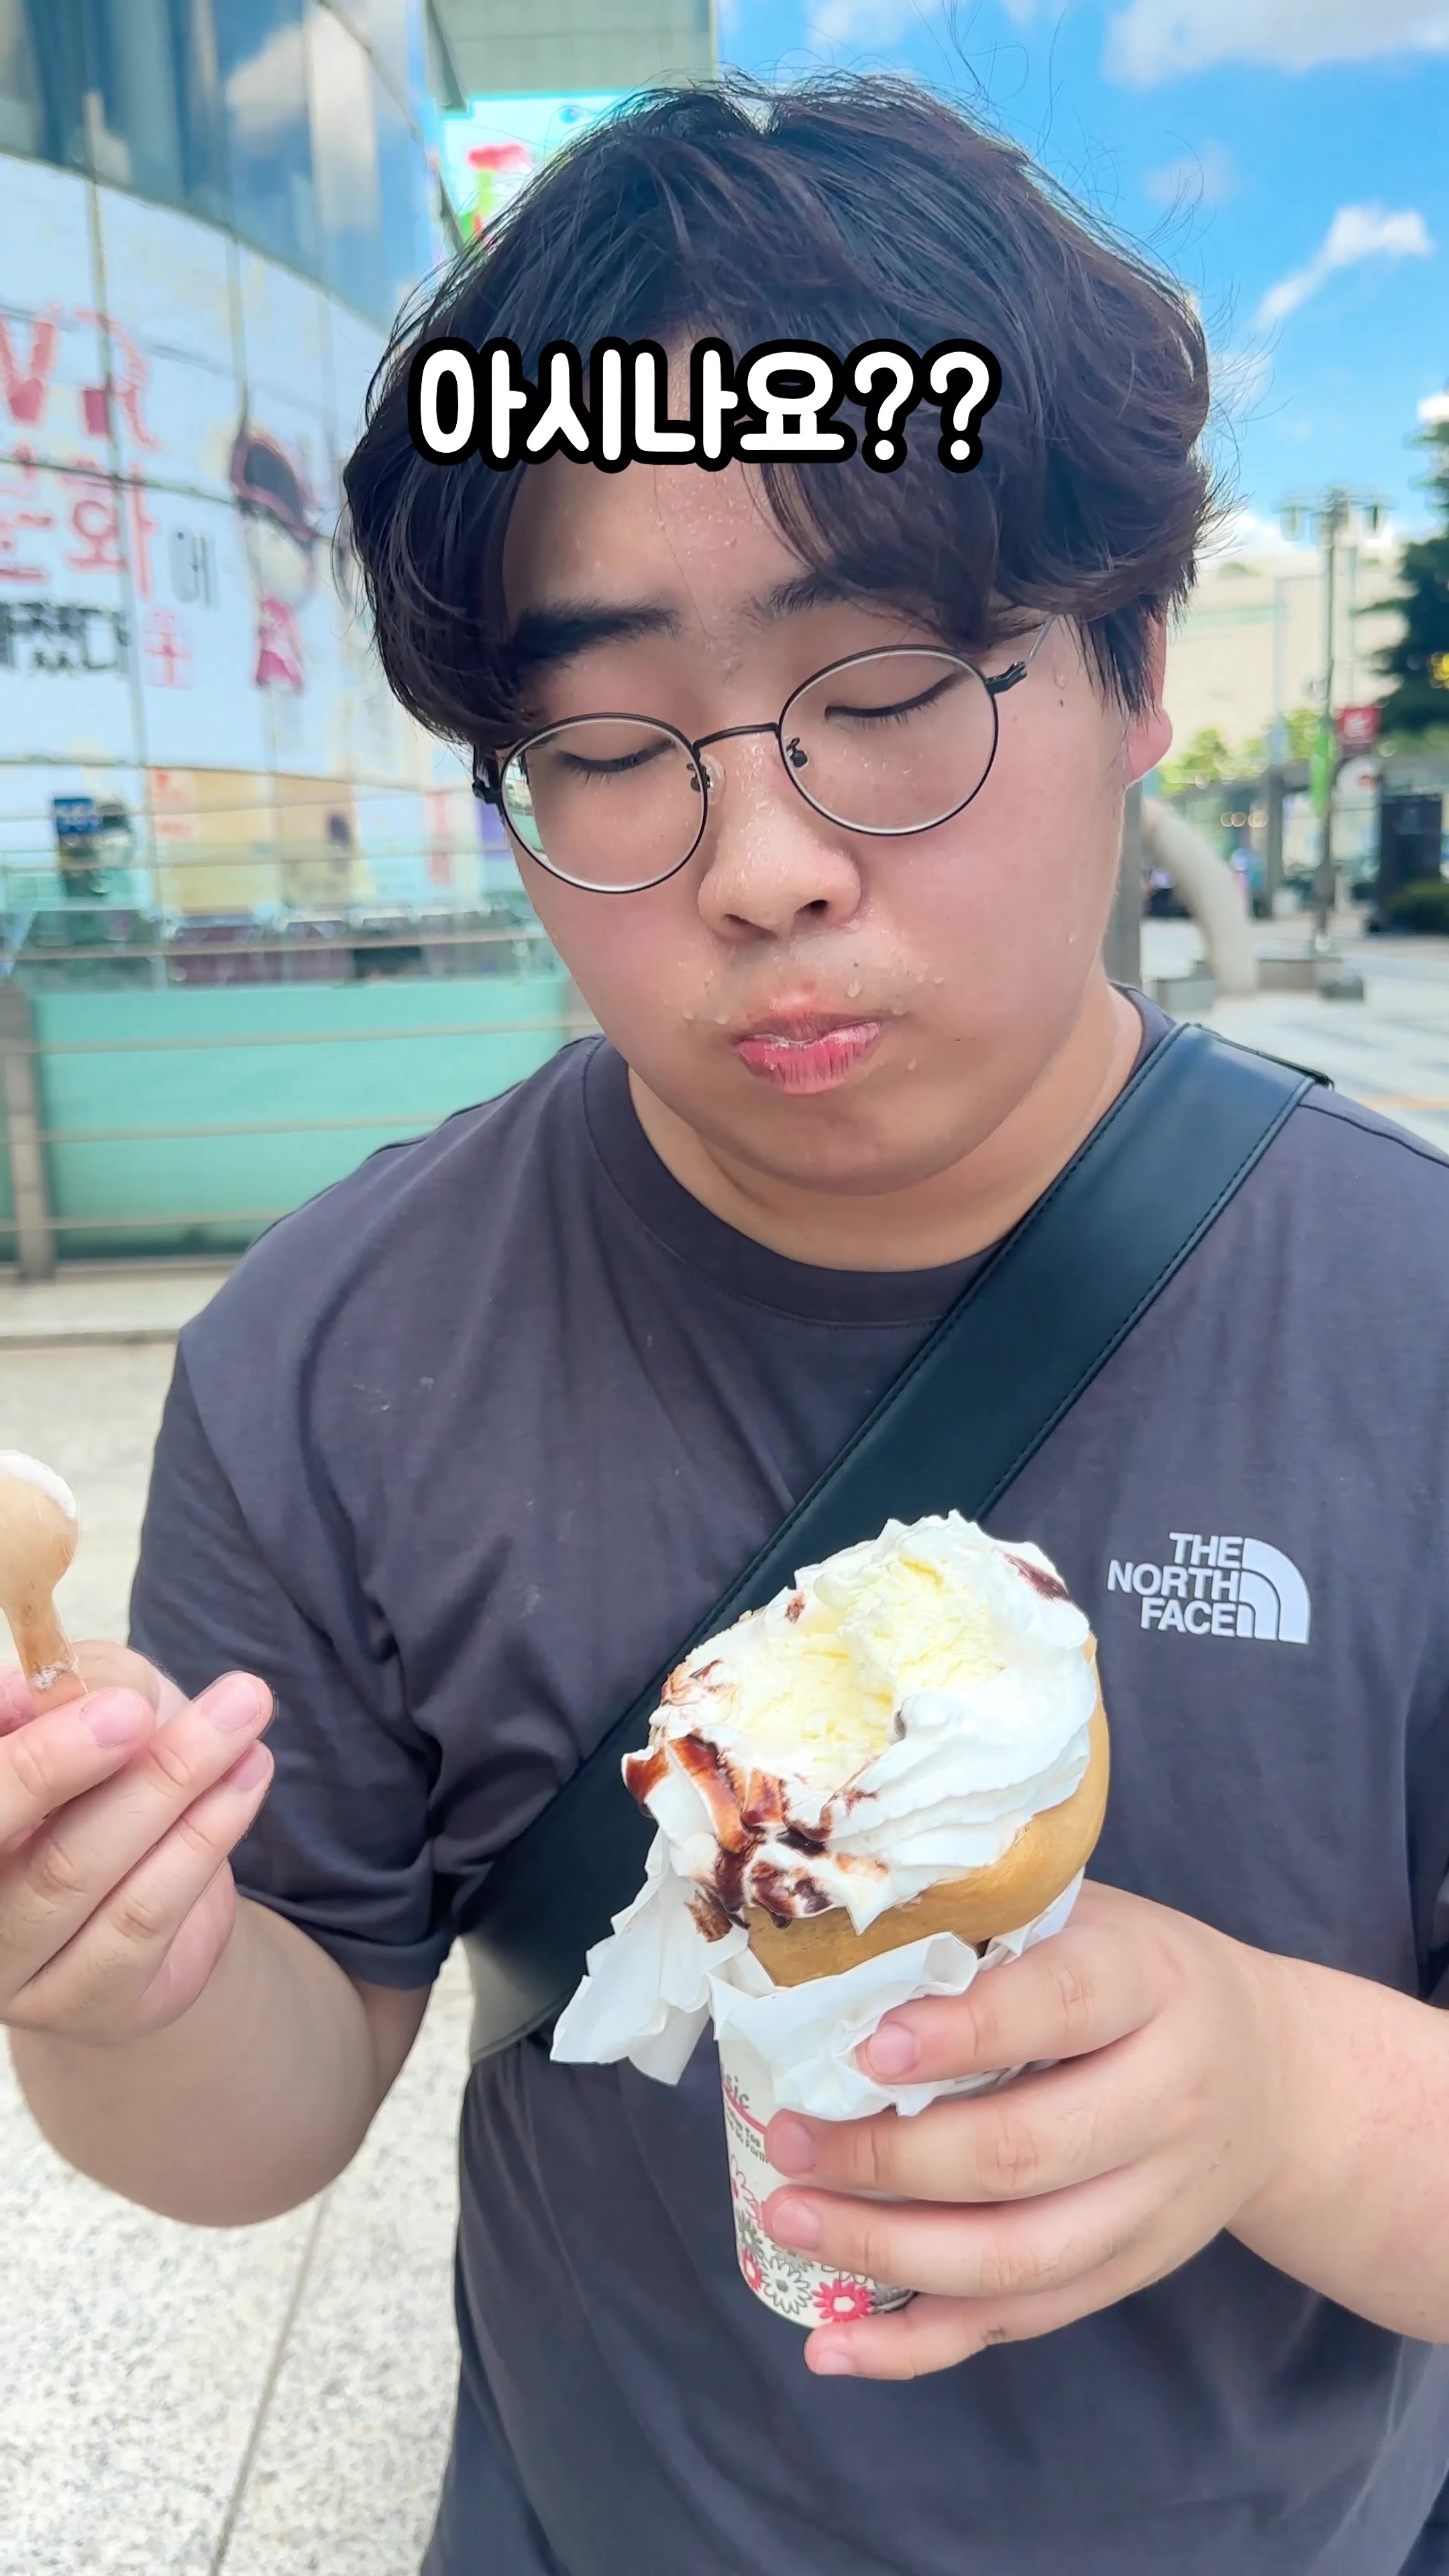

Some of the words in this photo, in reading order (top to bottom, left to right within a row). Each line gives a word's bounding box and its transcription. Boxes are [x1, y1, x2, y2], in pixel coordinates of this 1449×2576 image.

[1169, 1532, 1244, 1569] THE
[1107, 1560, 1240, 1603] NORTH
[1140, 1597, 1237, 1637] FACE
